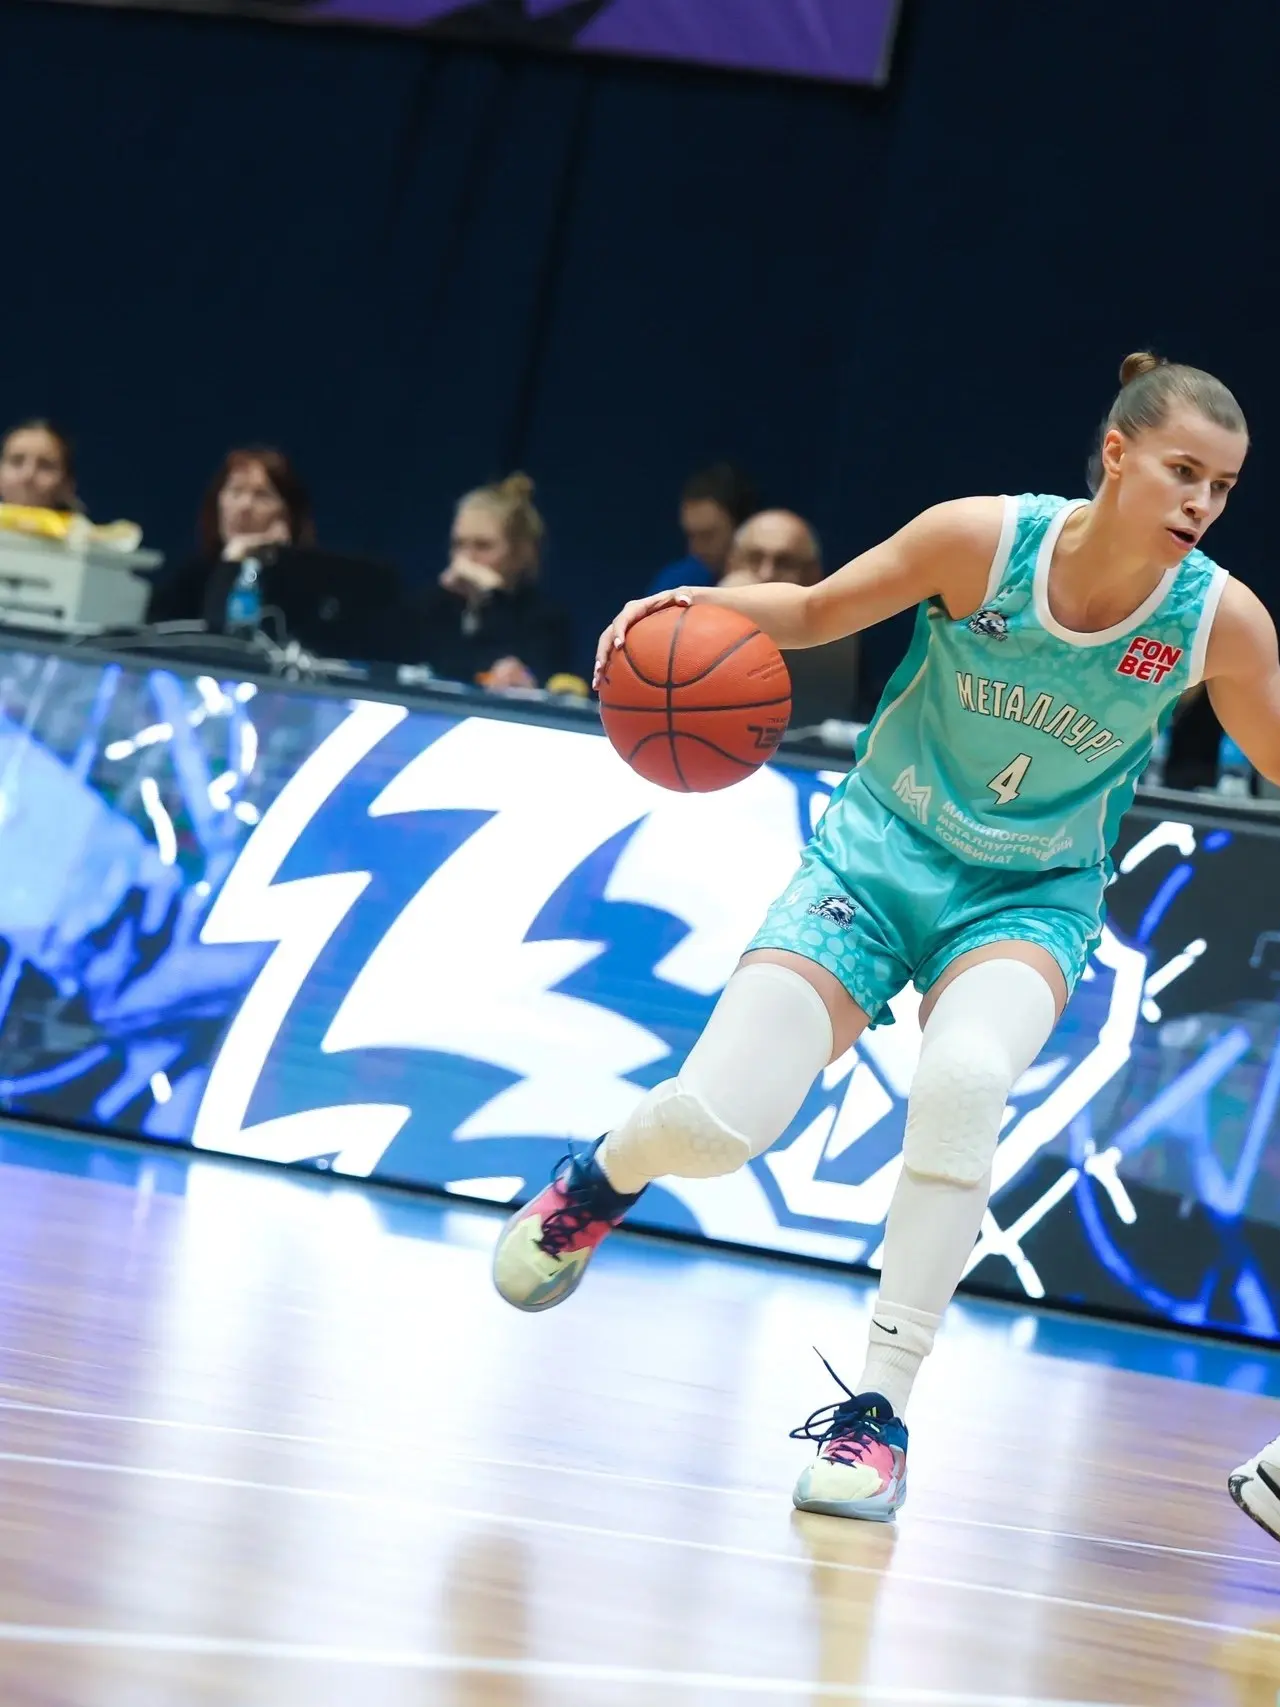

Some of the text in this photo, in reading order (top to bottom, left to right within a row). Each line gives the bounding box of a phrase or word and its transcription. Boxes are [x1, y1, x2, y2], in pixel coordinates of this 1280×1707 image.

[1116, 654, 1172, 684] BET
[1128, 637, 1183, 667] FON
[956, 671, 1124, 763] МЕТАЛЛУРГ
[986, 753, 1032, 805] 4
[935, 826, 1014, 864] КОМБИНАТ
